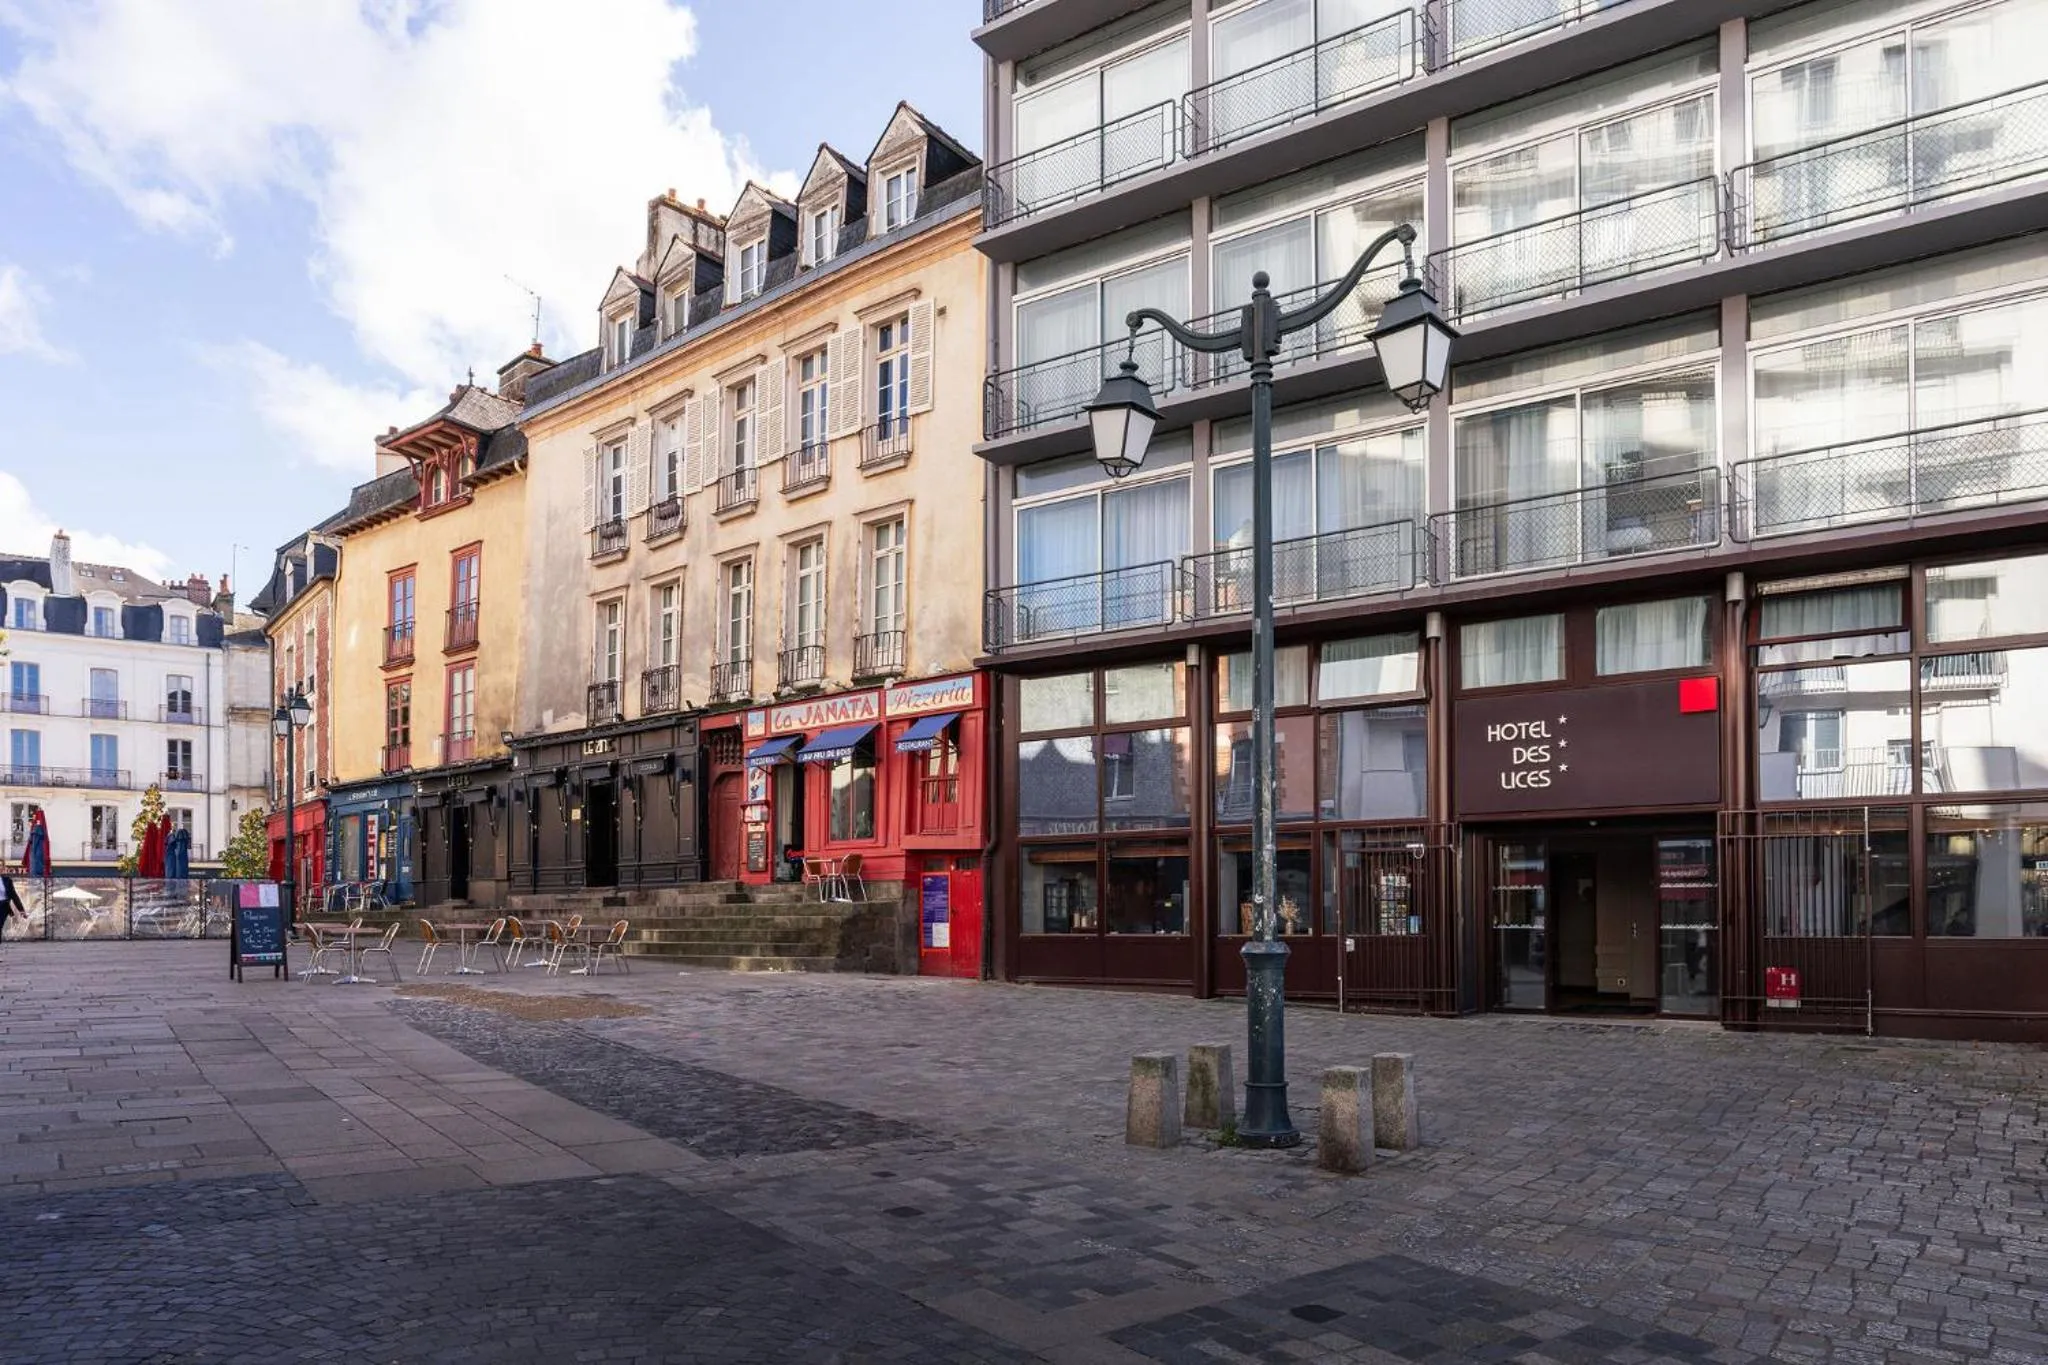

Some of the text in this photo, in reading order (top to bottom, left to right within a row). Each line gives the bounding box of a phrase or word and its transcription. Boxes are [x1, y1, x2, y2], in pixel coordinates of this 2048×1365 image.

[894, 681, 969, 711] Pizzeria
[799, 695, 875, 726] JANATA
[1487, 720, 1552, 742] HOTEL
[1512, 744, 1551, 765] DES
[1501, 769, 1552, 789] LICES
[1781, 973, 1796, 987] H
